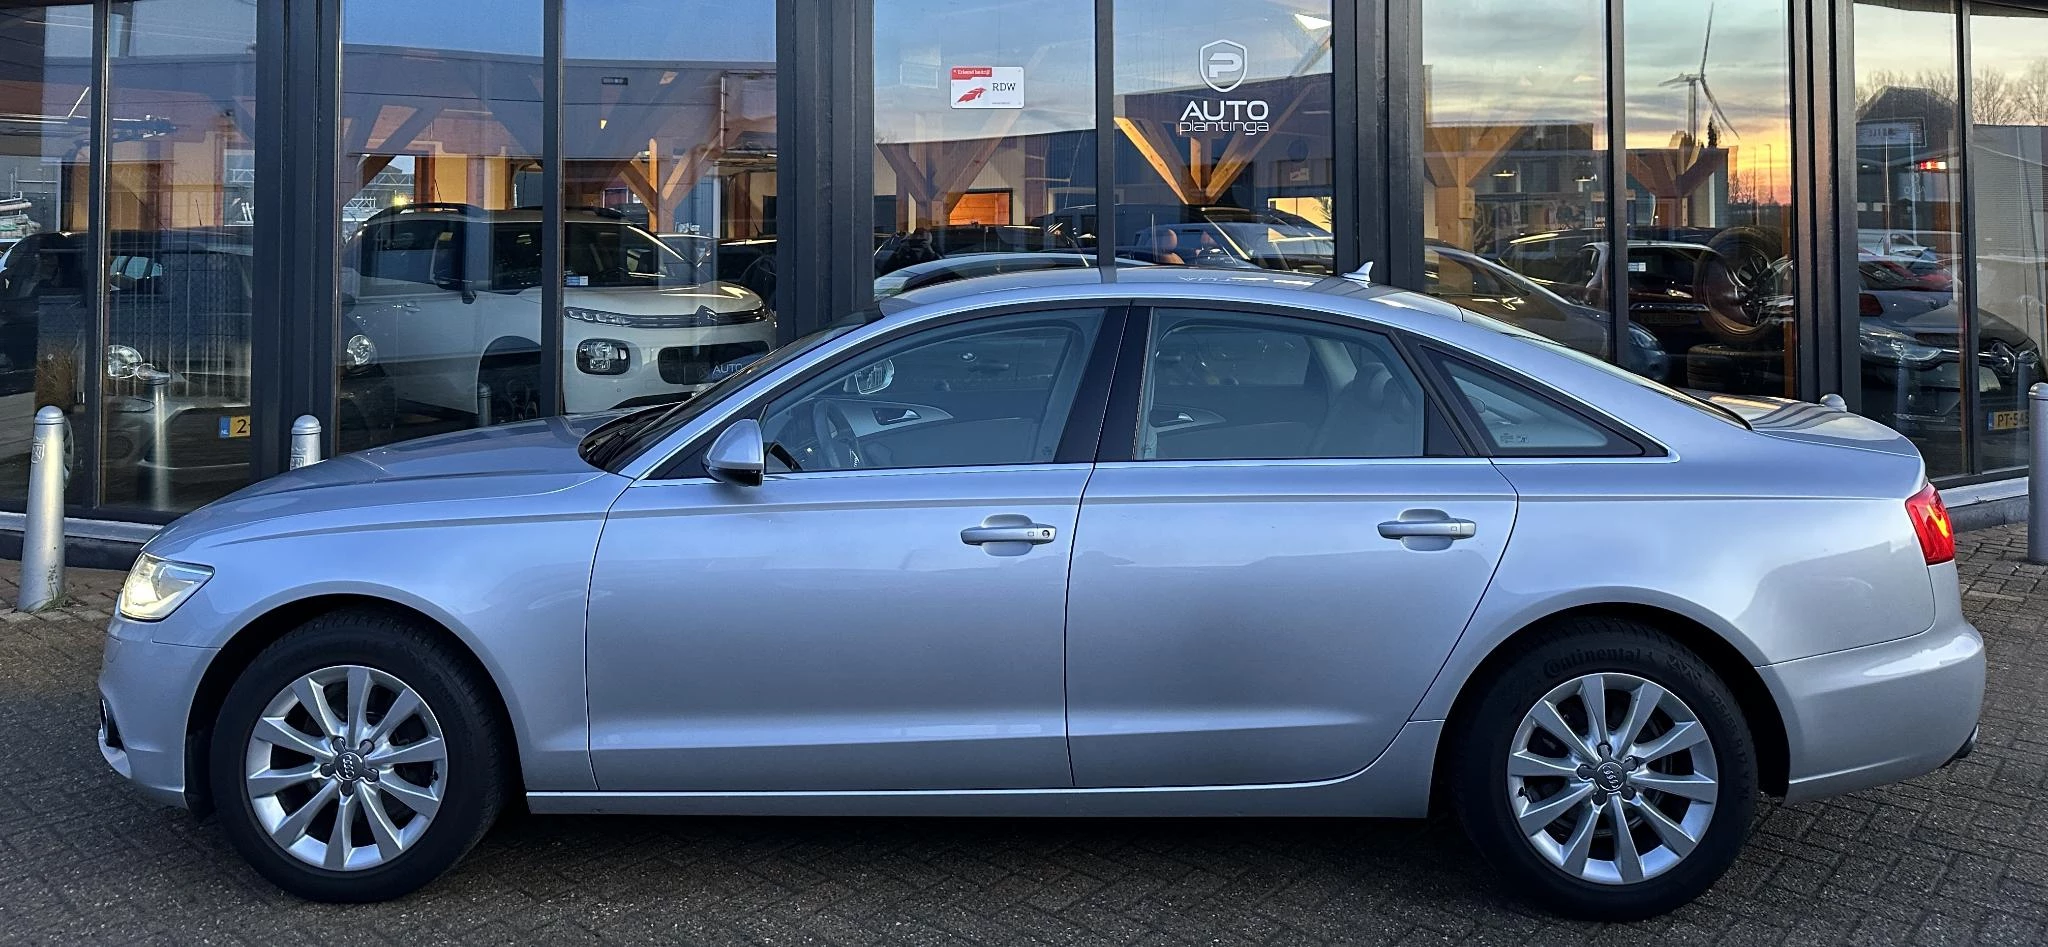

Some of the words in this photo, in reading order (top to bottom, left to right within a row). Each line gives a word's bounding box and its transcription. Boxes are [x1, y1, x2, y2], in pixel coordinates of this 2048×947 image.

[992, 82, 1016, 92] RDW
[1180, 100, 1269, 121] AUTO
[1179, 120, 1270, 136] plantinga
[712, 363, 743, 375] AUTO
[1543, 647, 1642, 677] Continental
